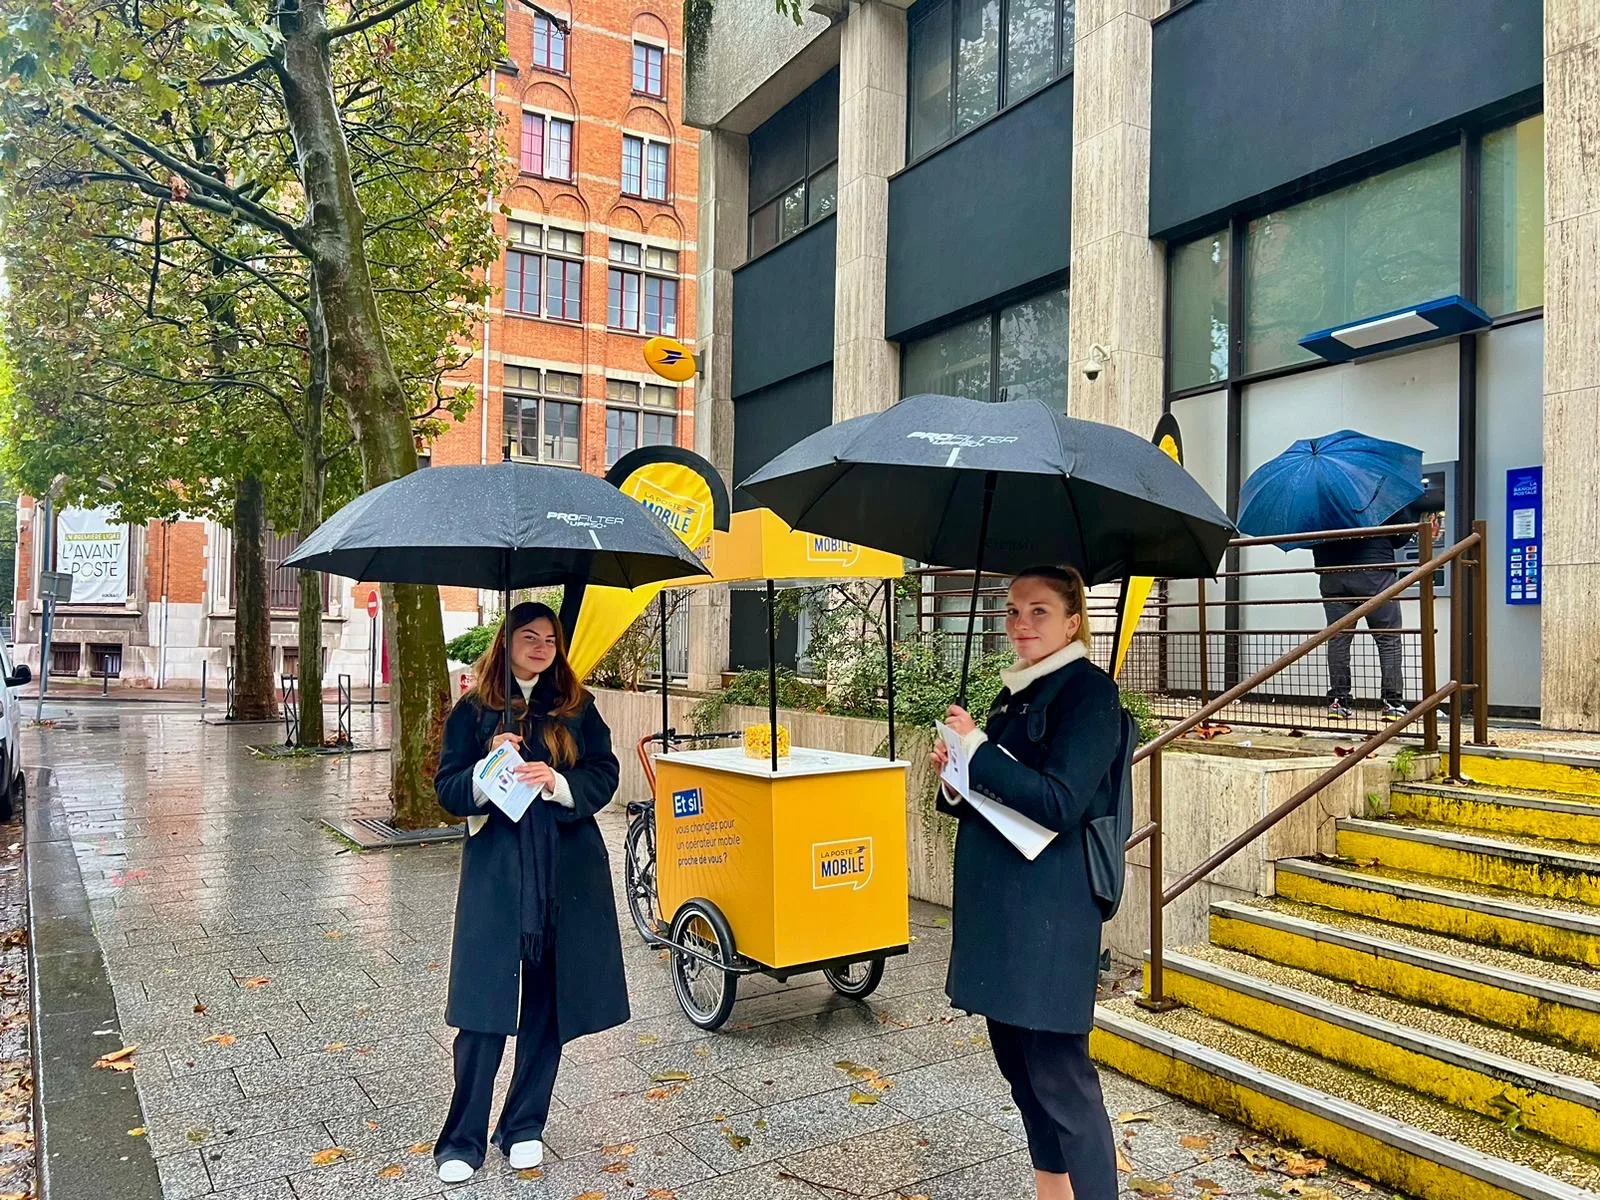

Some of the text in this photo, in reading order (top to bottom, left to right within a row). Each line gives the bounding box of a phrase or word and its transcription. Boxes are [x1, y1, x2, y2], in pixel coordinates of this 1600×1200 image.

[644, 491, 682, 511] LA POSTE
[546, 511, 625, 526] PROFILTER
[62, 543, 121, 559] L'AVANT
[674, 795, 687, 814] Et
[675, 819, 735, 835] vous changiez pour
[677, 834, 741, 852] un opérateur mobile
[820, 848, 853, 859] LA POSTE
[677, 854, 698, 870] proche
[698, 854, 707, 865] de
[707, 855, 722, 864] vous
